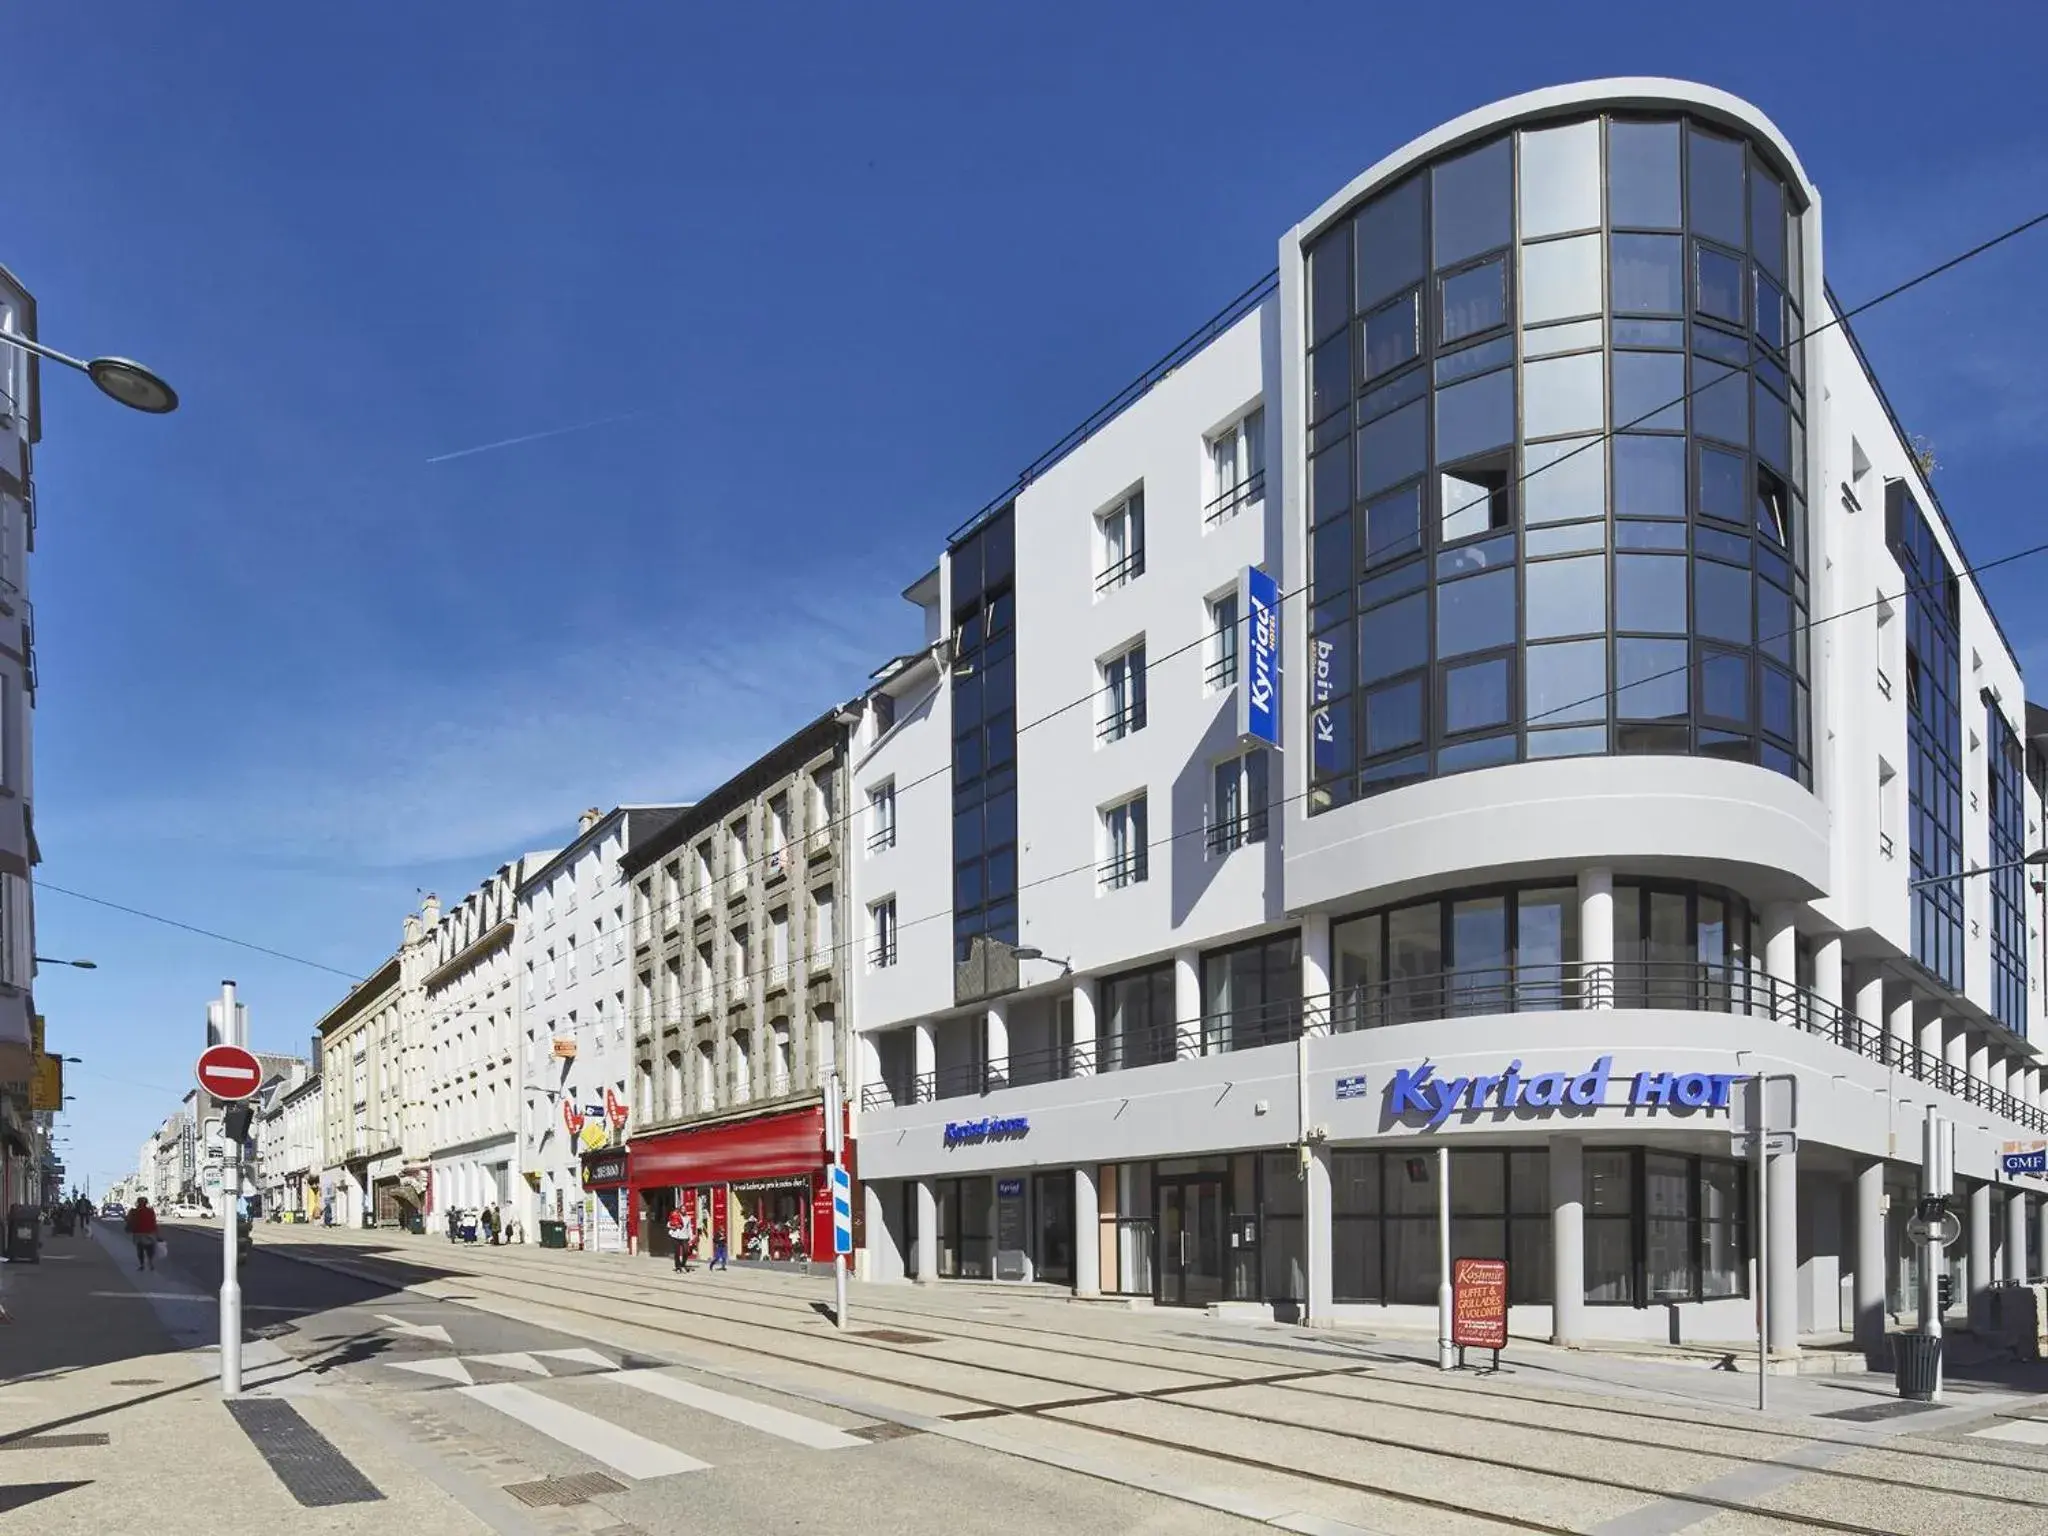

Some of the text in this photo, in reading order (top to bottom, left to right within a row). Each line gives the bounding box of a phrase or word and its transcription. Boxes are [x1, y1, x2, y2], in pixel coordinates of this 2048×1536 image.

[1252, 595, 1273, 713] Kyriad
[1390, 1056, 1738, 1125] Kyriad HOT
[2006, 1156, 2043, 1169] GMF
[1457, 1262, 1501, 1284] Kashmir
[1459, 1287, 1487, 1299] BUFFET
[1457, 1296, 1501, 1308] GRILLADES
